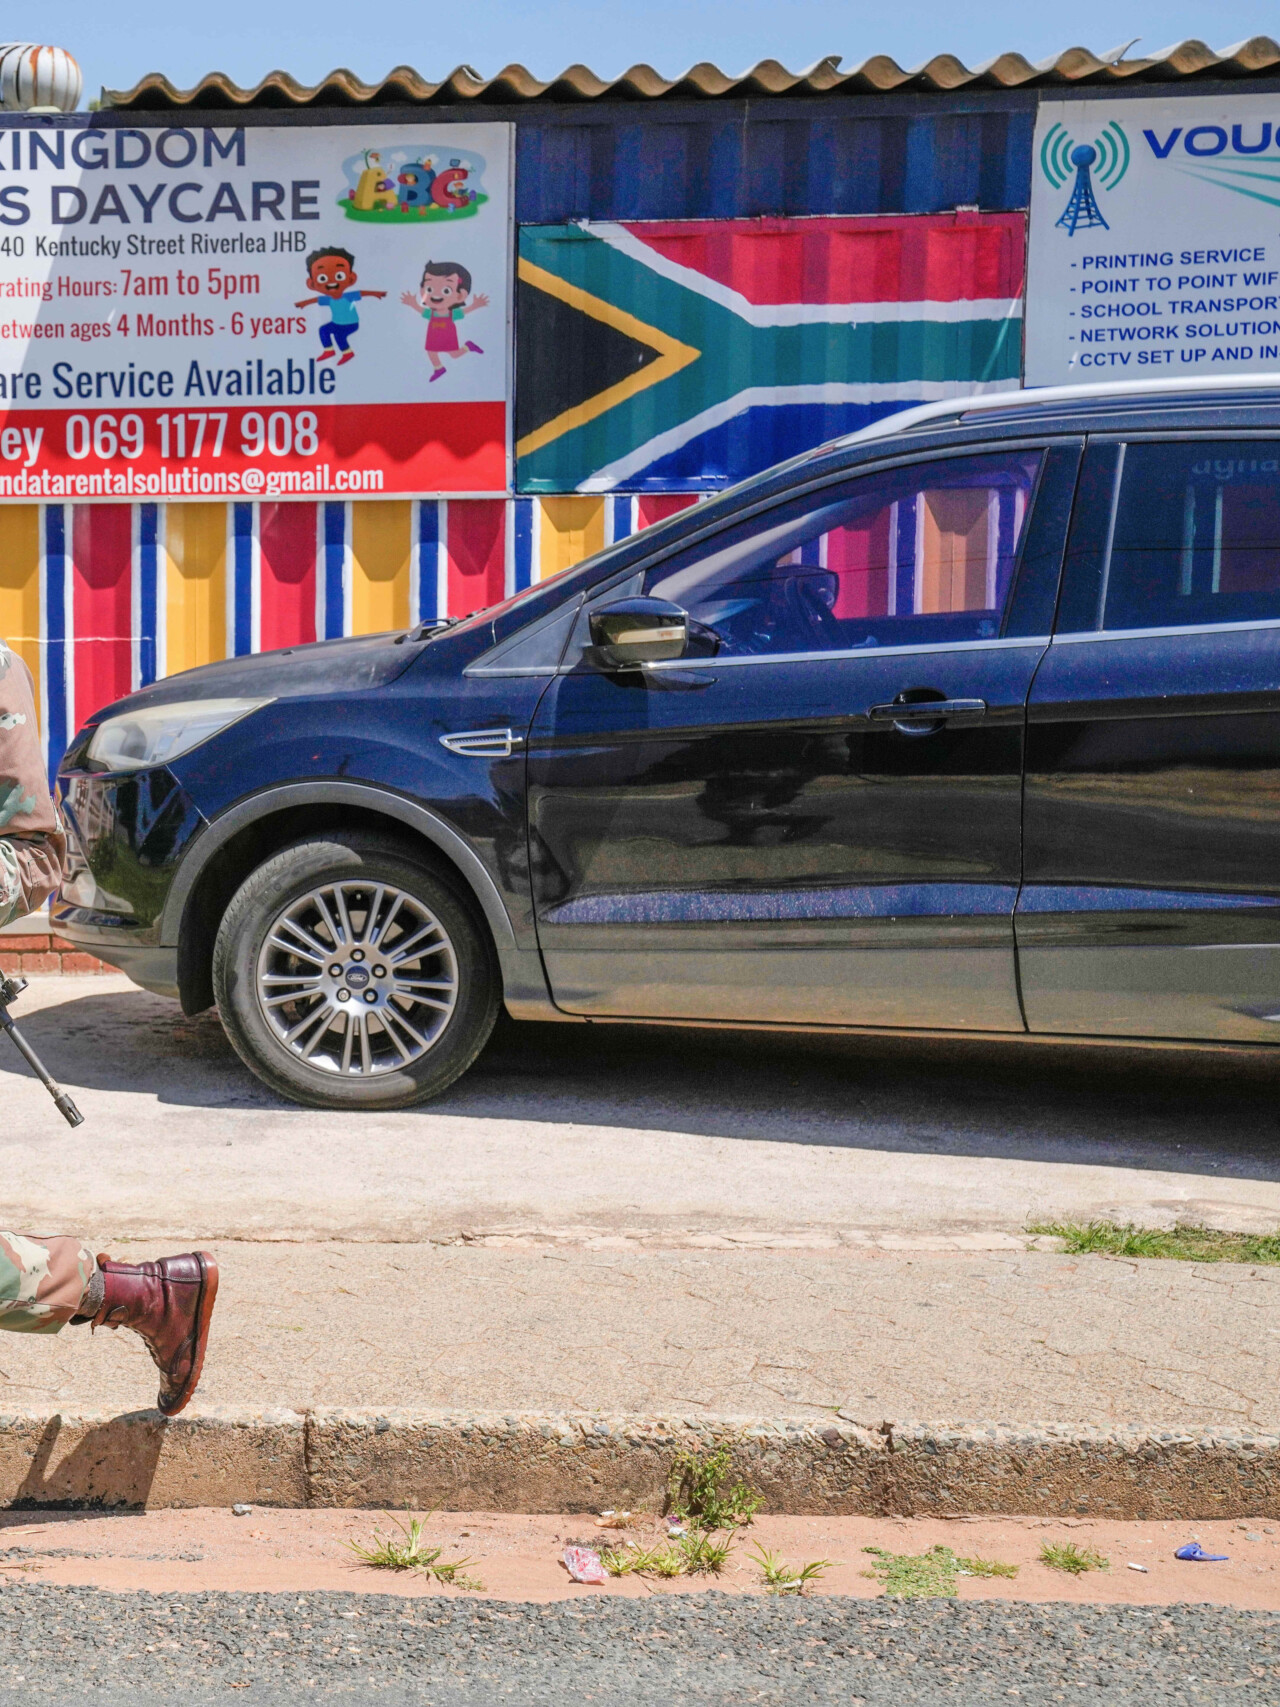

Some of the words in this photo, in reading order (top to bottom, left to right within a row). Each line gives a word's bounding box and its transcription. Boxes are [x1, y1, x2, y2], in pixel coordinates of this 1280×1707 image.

[1142, 122, 1280, 159] VOU
[49, 180, 320, 225] DAYCARE
[0, 236, 25, 257] 40
[36, 233, 121, 259] Kentucky
[126, 233, 185, 256] Street
[191, 231, 266, 255] Riverlea
[271, 230, 307, 253] JHB
[1082, 252, 1174, 270] PRINTING
[1179, 247, 1266, 265] SERVICE
[57, 275, 118, 297] Hours:
[120, 269, 169, 297] 7am
[176, 269, 200, 296] to
[207, 267, 260, 300] 5pm
[1081, 278, 1140, 295] POINT
[1145, 276, 1172, 291] TO
[1177, 273, 1238, 290] POINT
[1080, 301, 1163, 319] SCHOOL
[1167, 295, 1280, 316] TRANSPOR
[70, 321, 112, 341] ages
[116, 313, 130, 337] 4
[136, 312, 215, 337] Months
[231, 311, 244, 336] 6
[250, 315, 307, 338] years
[1080, 325, 1179, 343] NETWORK
[1079, 351, 1132, 367] CCTV
[1137, 349, 1175, 365] SET
[1180, 348, 1207, 363] UP
[1210, 346, 1254, 361] AND
[1259, 343, 1280, 360] IN
[52, 361, 174, 399] Service
[183, 357, 337, 397] Available
[65, 413, 145, 460] 069
[156, 412, 229, 459] 1177
[240, 410, 319, 457] 908
